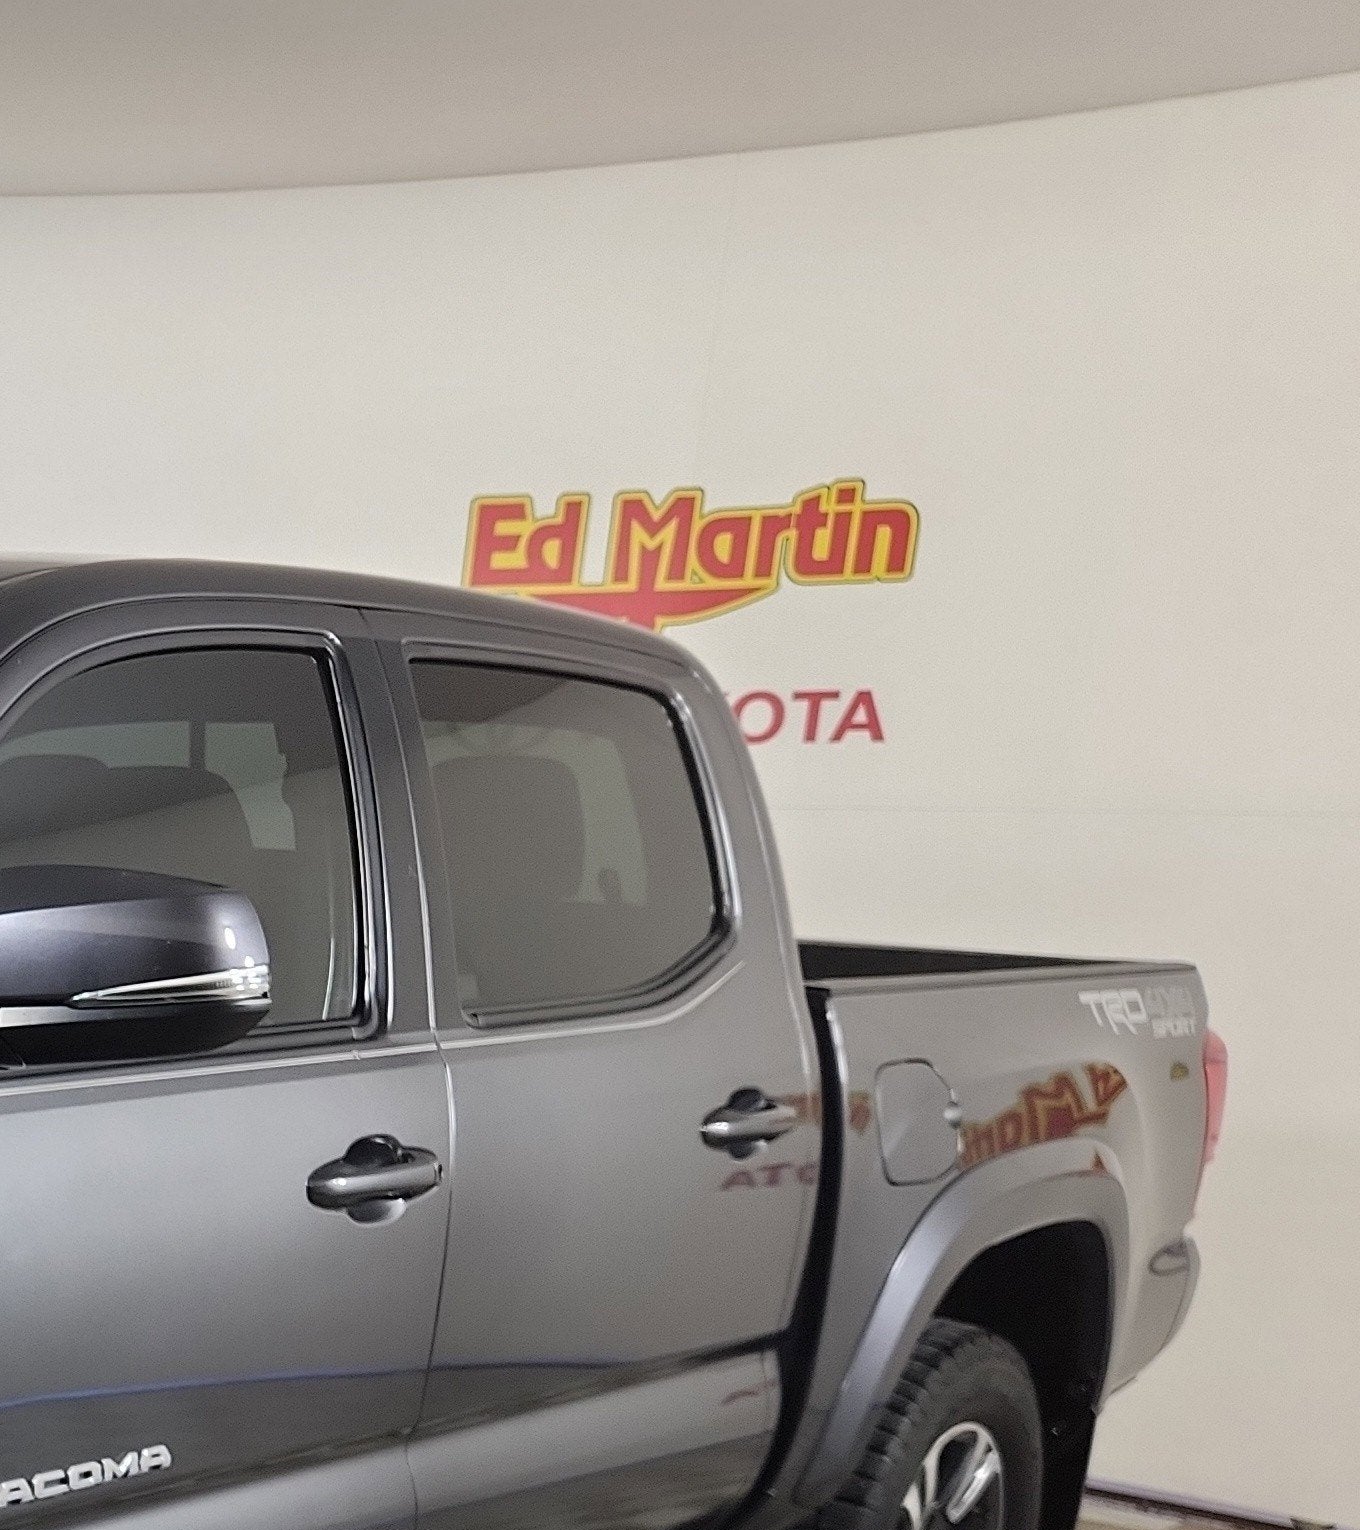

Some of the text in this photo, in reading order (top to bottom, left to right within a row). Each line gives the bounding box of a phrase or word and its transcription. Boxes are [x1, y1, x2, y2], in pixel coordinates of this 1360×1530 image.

[469, 481, 918, 587] Ed Martin
[733, 689, 885, 743] OTA
[1078, 986, 1148, 1036] TRD
